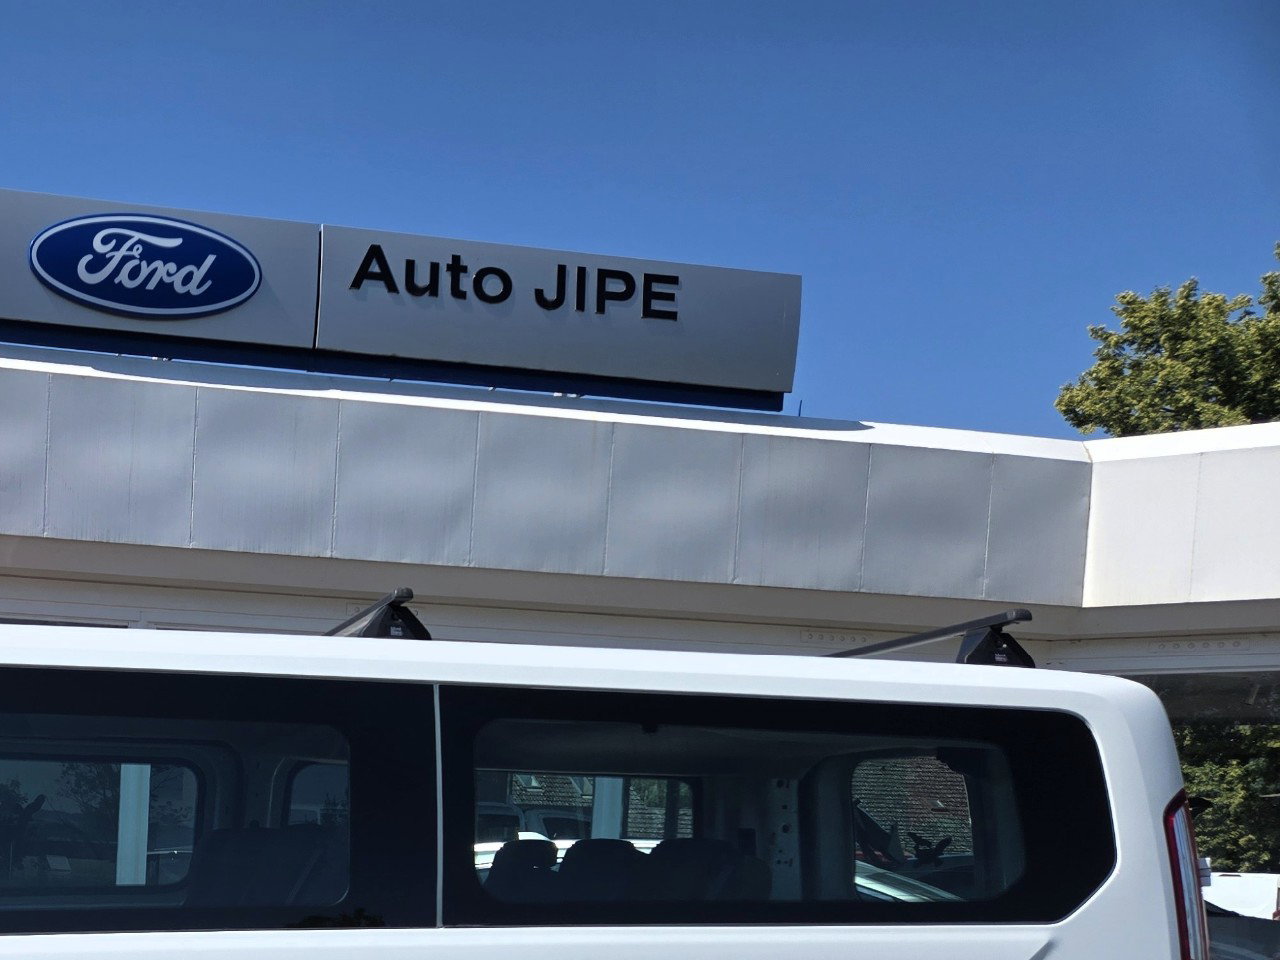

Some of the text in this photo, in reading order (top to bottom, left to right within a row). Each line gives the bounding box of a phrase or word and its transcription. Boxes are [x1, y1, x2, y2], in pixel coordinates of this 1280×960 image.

[77, 228, 217, 295] Ford
[349, 244, 680, 321] Auto JIPE
